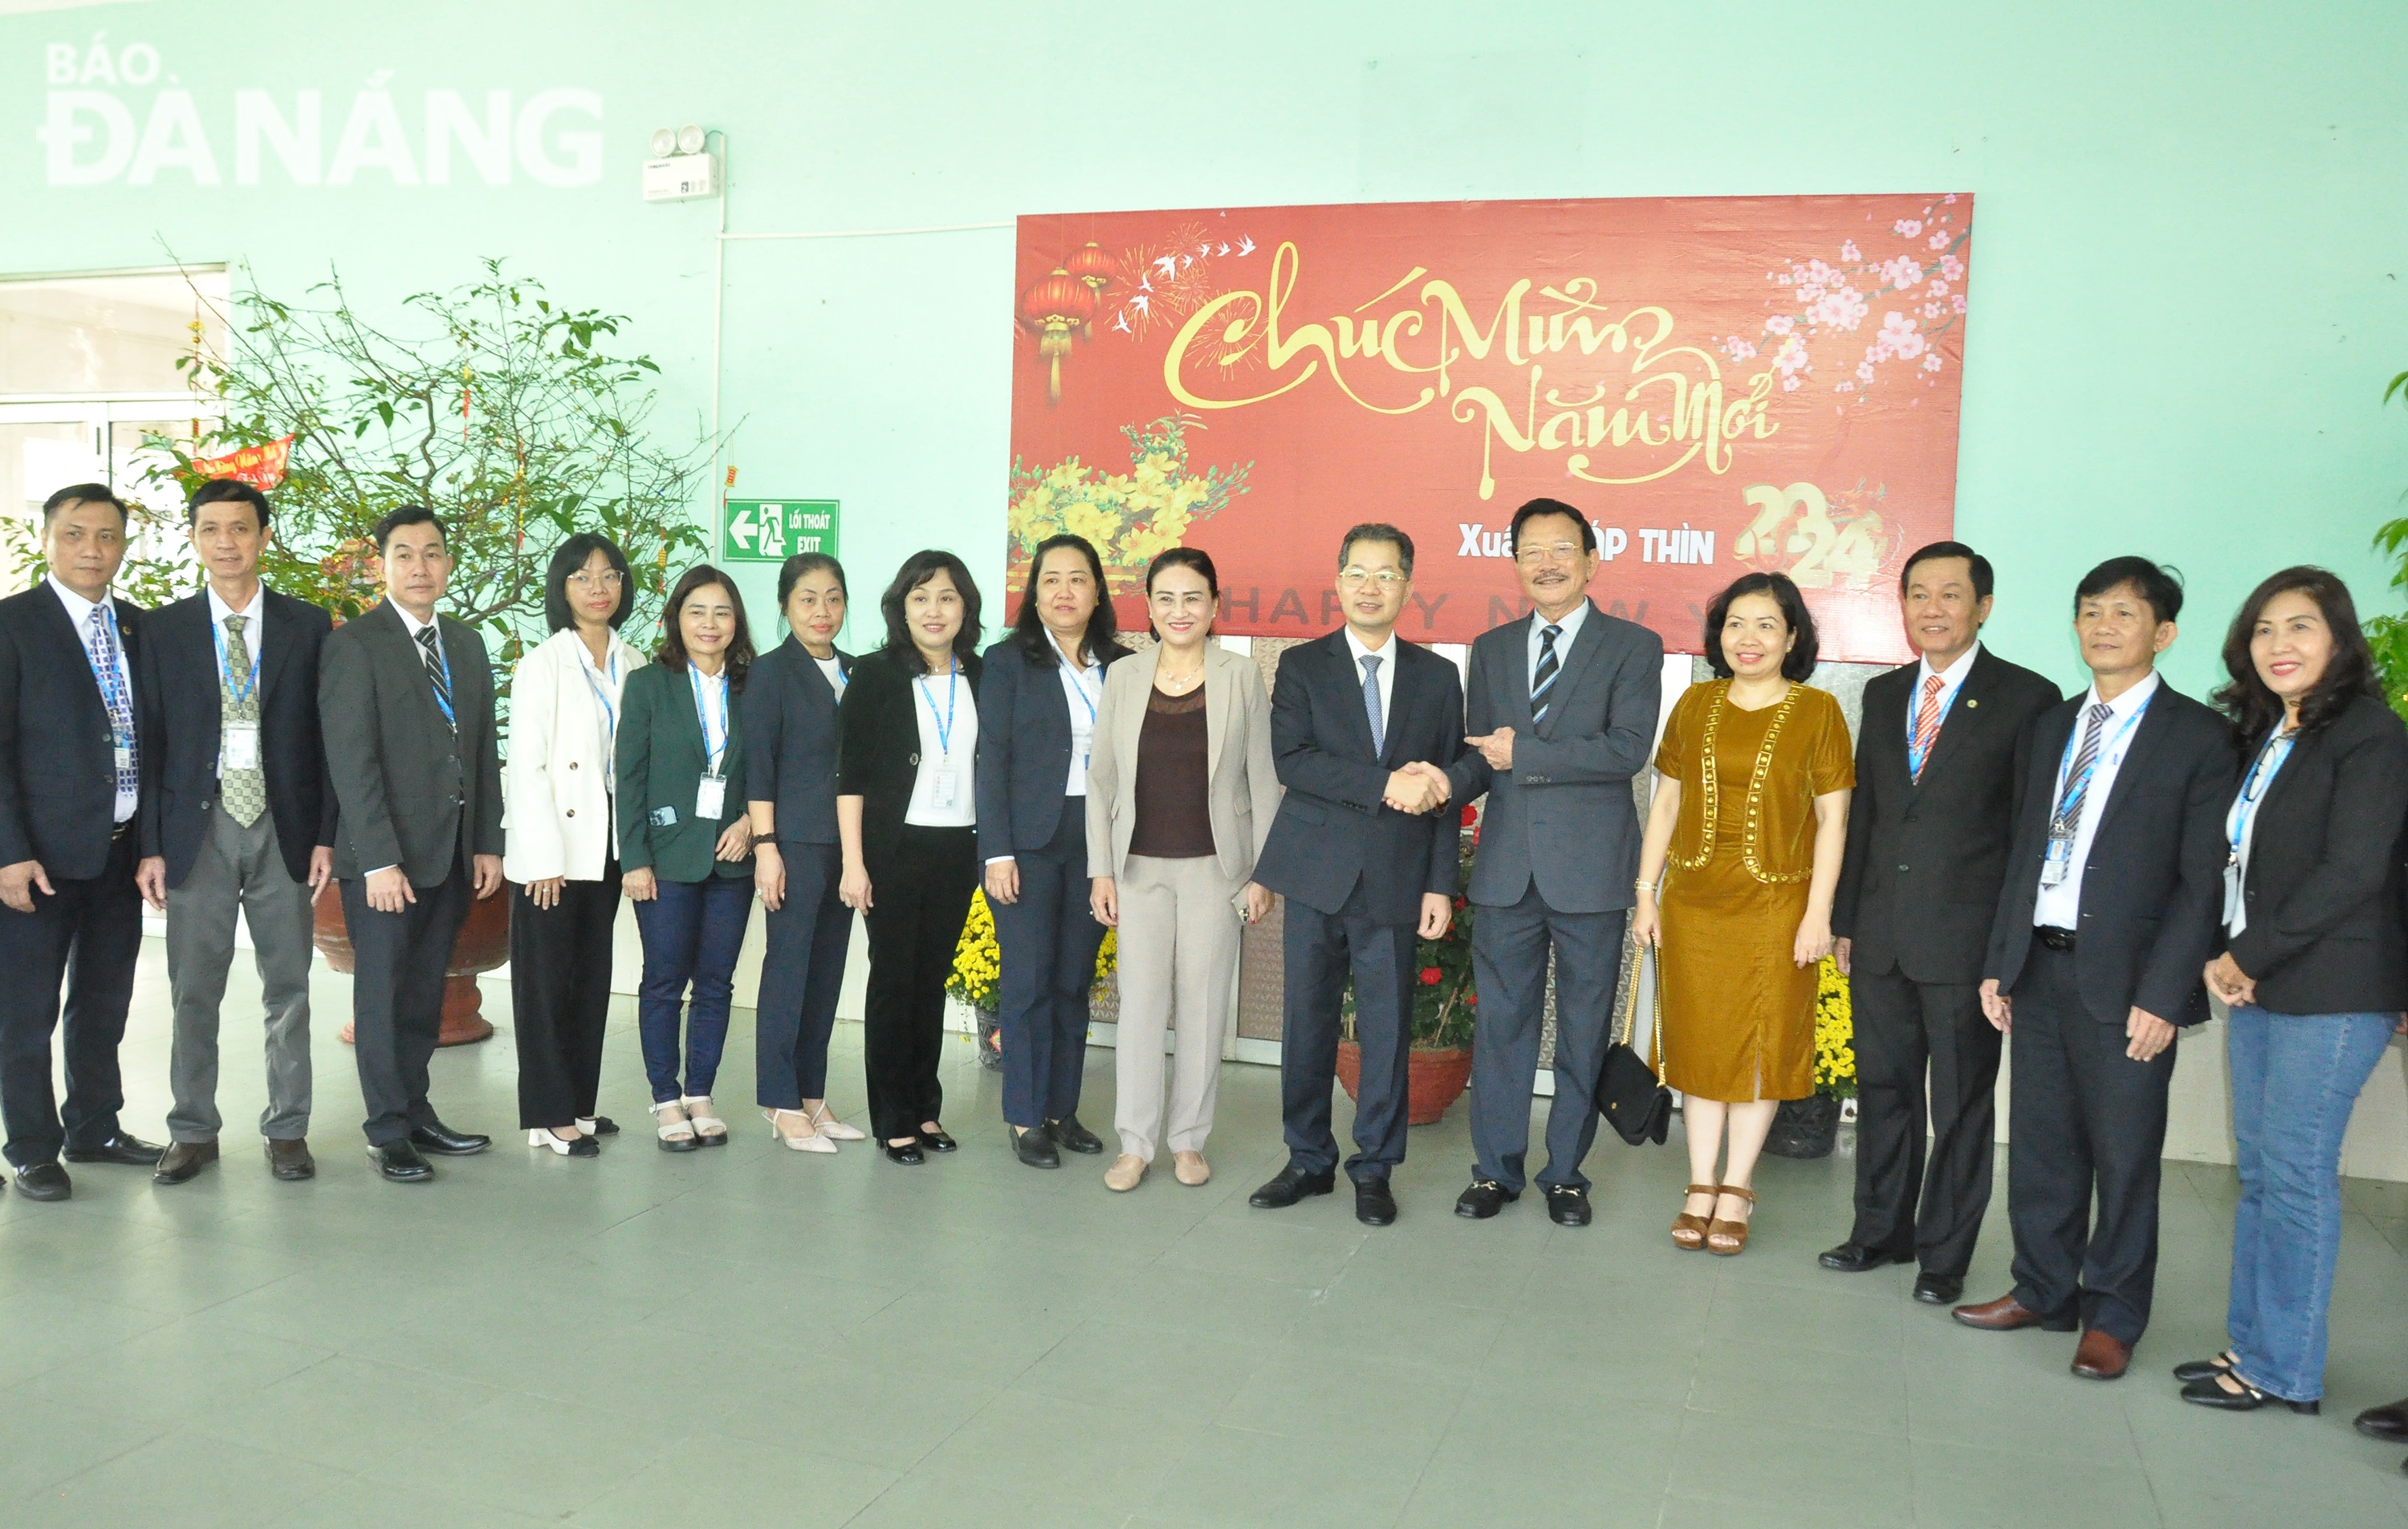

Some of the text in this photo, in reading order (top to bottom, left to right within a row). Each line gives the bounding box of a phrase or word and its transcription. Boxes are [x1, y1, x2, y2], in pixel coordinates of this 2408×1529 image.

[1163, 241, 1720, 414] Chúc Mừng
[1451, 337, 1796, 499] Năm Mới
[788, 508, 831, 530] LỐI THOÁT
[797, 535, 822, 554] EXIT
[1638, 522, 1715, 565] THÌN
[1220, 585, 1448, 631] HAPY
